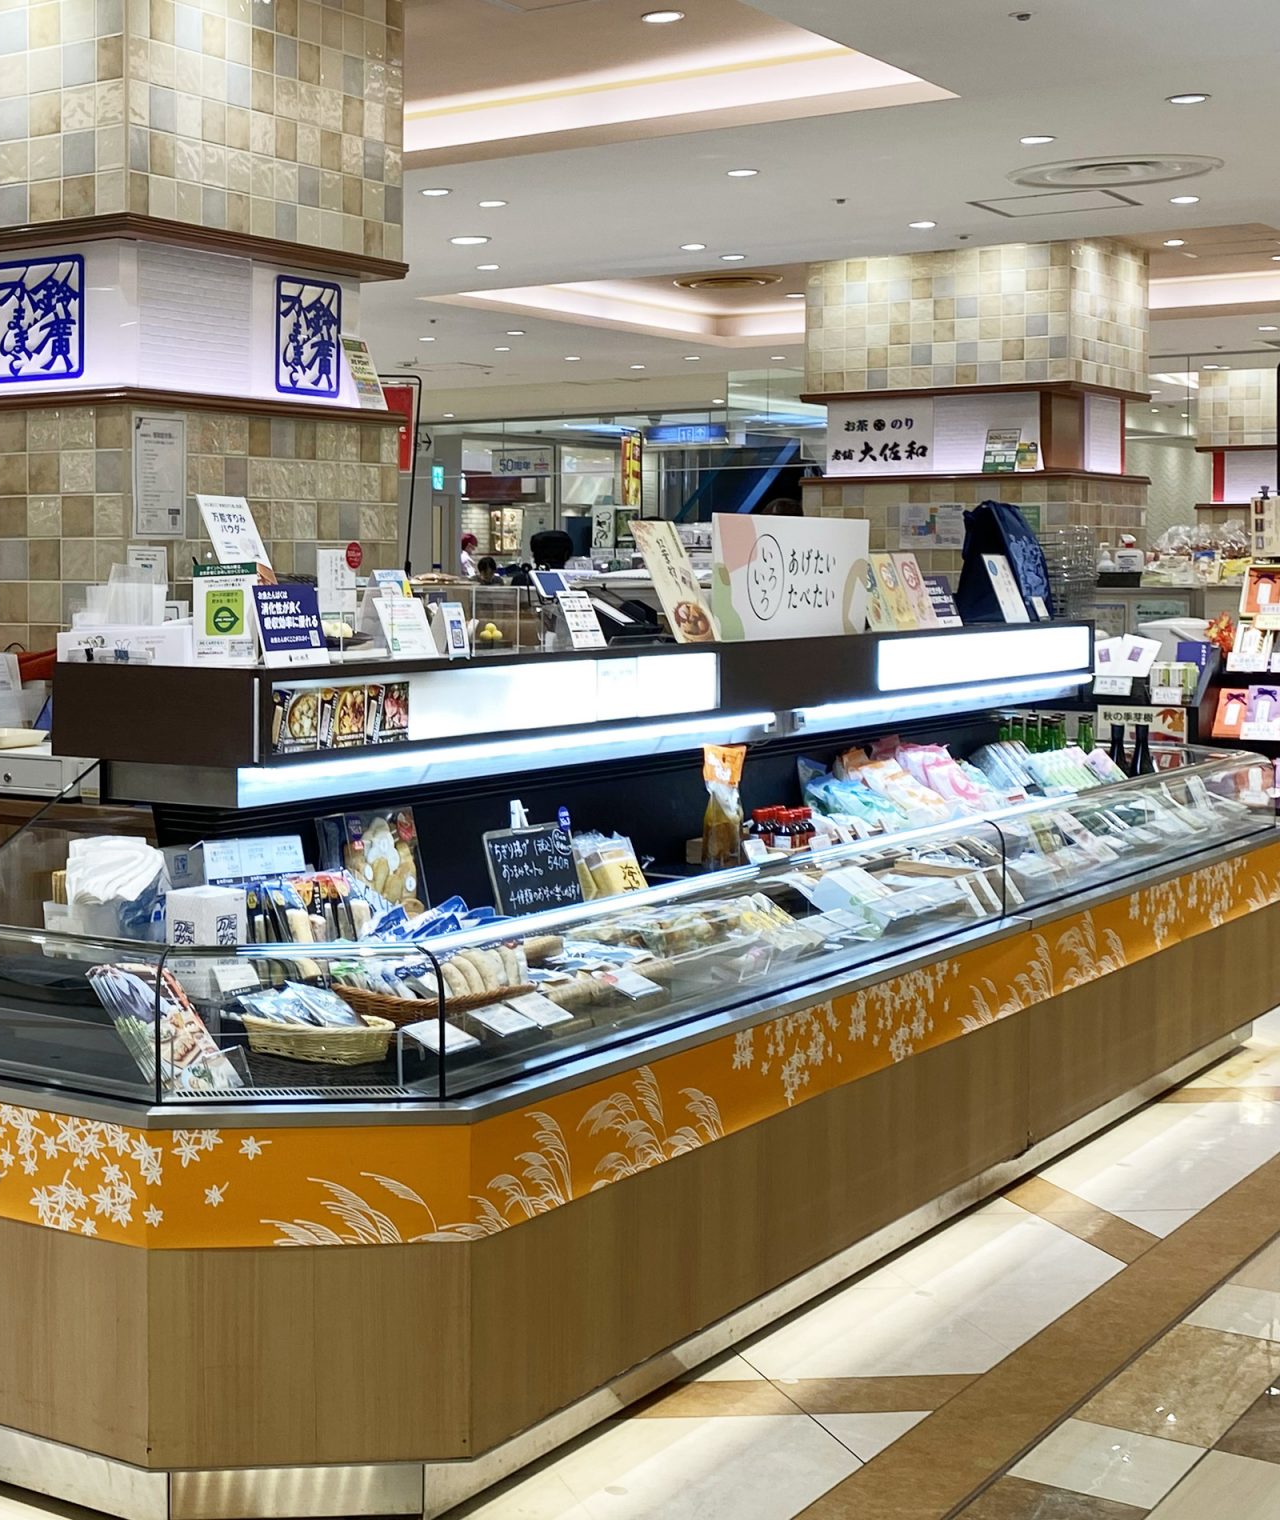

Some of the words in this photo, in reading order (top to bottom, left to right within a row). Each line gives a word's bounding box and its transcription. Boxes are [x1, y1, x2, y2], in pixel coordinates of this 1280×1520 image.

[844, 419, 869, 432] お茶
[891, 418, 914, 430] のり
[858, 440, 929, 463] 大佐和
[211, 512, 246, 524] 万能すりみ
[221, 524, 246, 534] パウダー
[788, 548, 836, 576] あげたい
[787, 583, 835, 609] たべたい
[261, 601, 302, 615] 消化性が良く
[547, 855, 570, 871] 540円
